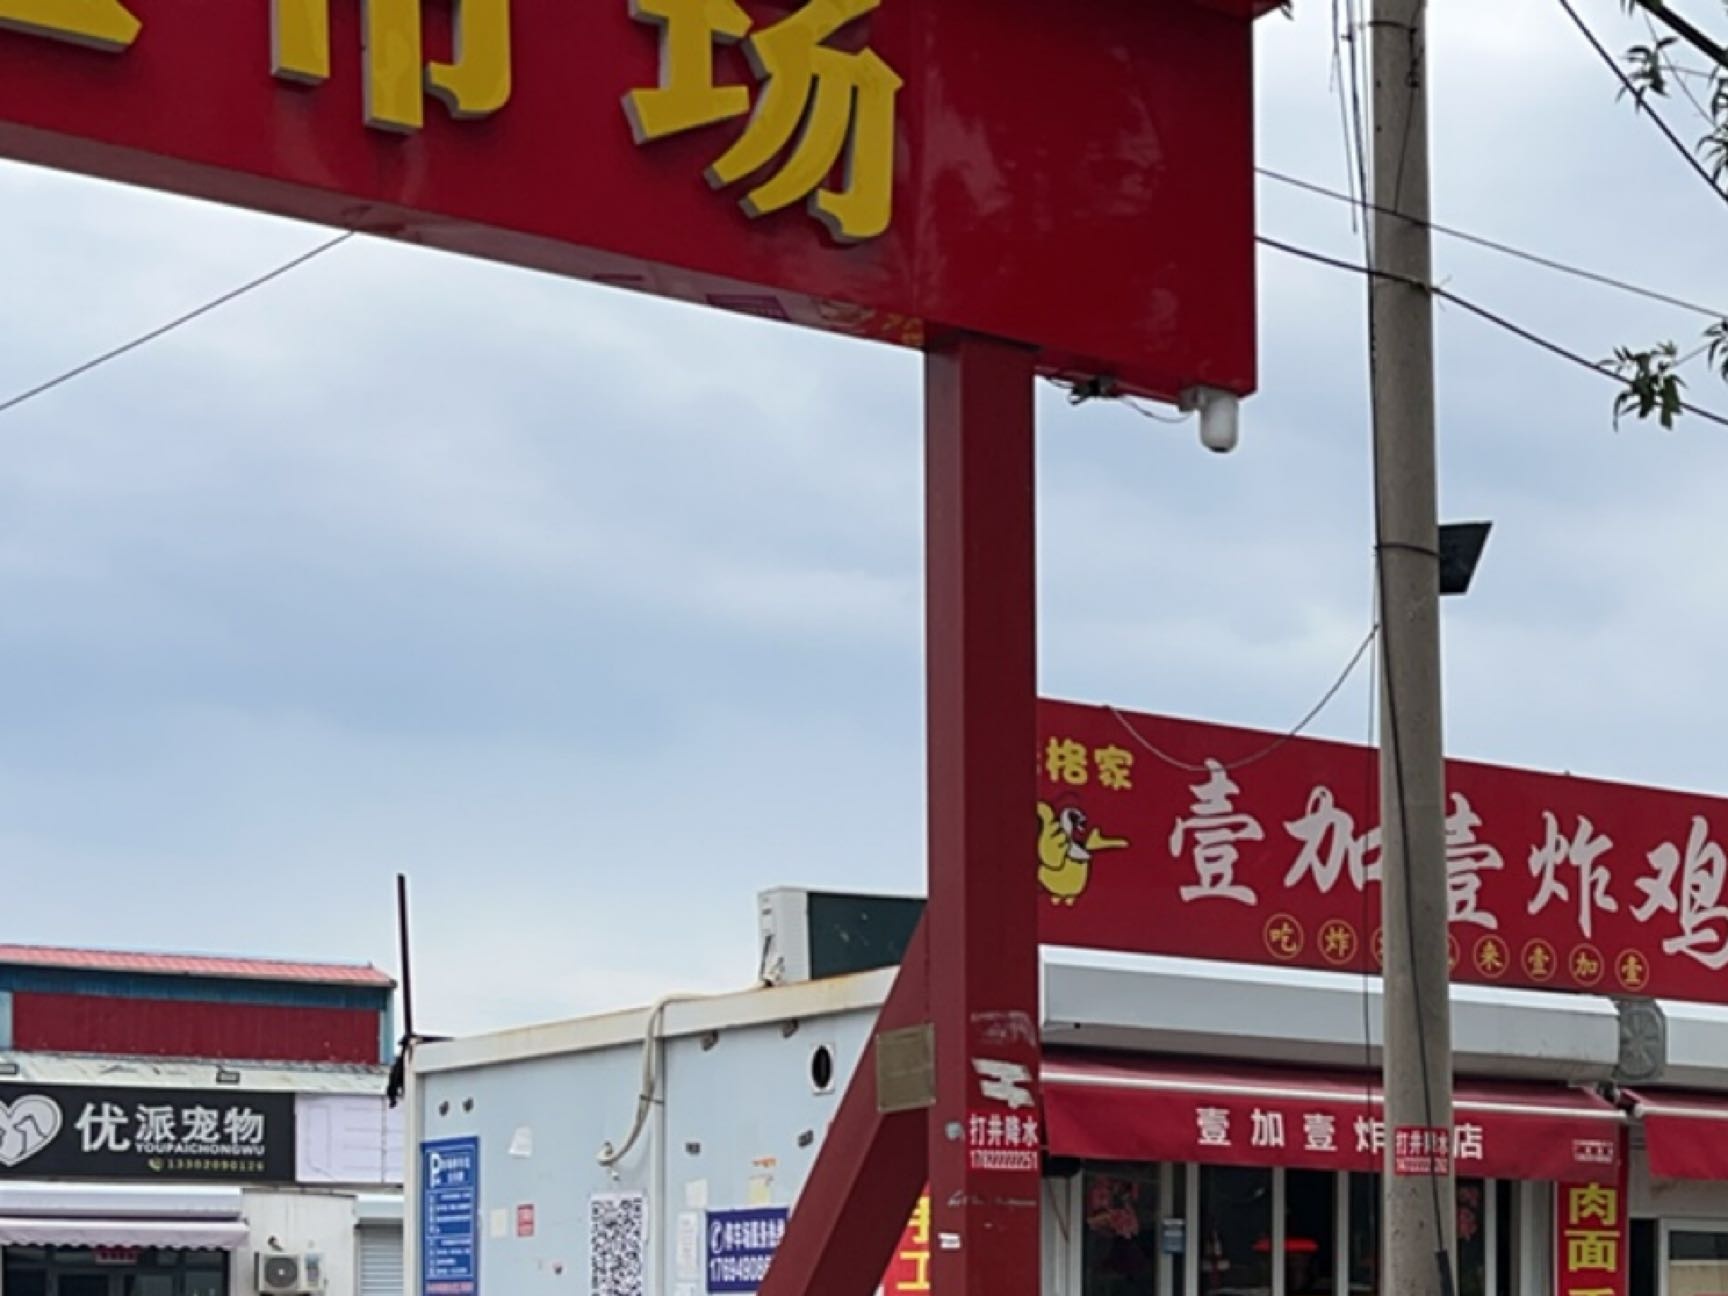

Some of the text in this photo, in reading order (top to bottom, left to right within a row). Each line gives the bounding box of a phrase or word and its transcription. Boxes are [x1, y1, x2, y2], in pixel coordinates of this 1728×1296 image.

[1265, 918, 1648, 990] 吃炸来壹加壹
[74, 1102, 265, 1152] 优派宠物
[969, 1114, 1039, 1147] 打井降水
[1196, 1107, 1483, 1160] 壹加壹炸店
[1564, 1182, 1620, 1272] 肉面
